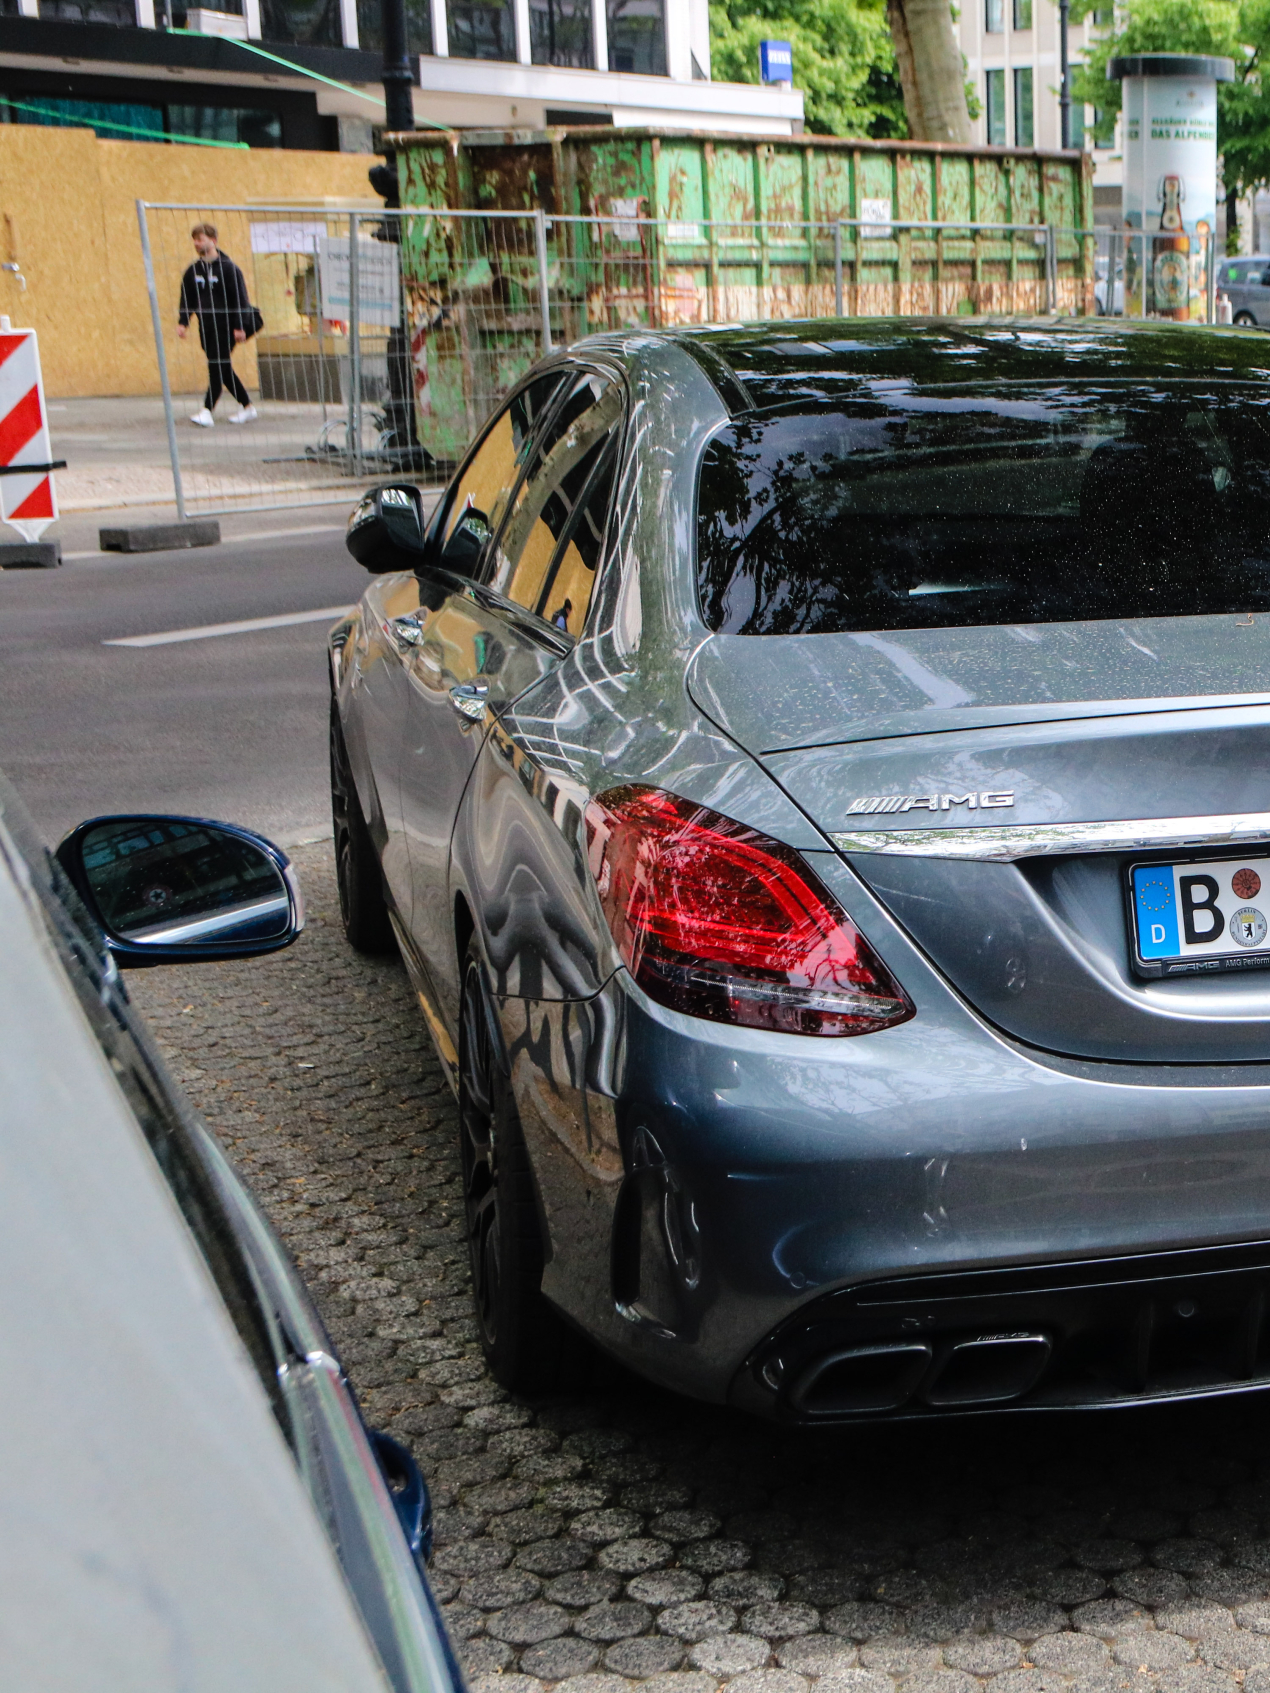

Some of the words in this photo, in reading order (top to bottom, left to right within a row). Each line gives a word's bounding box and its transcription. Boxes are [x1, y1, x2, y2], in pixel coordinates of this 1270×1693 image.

[1151, 128, 1171, 139] DAS
[898, 790, 1015, 811] AMG
[1151, 923, 1166, 943] D
[1179, 874, 1225, 944] B
[1186, 962, 1220, 970] AMG
[1226, 959, 1241, 968] AMG
